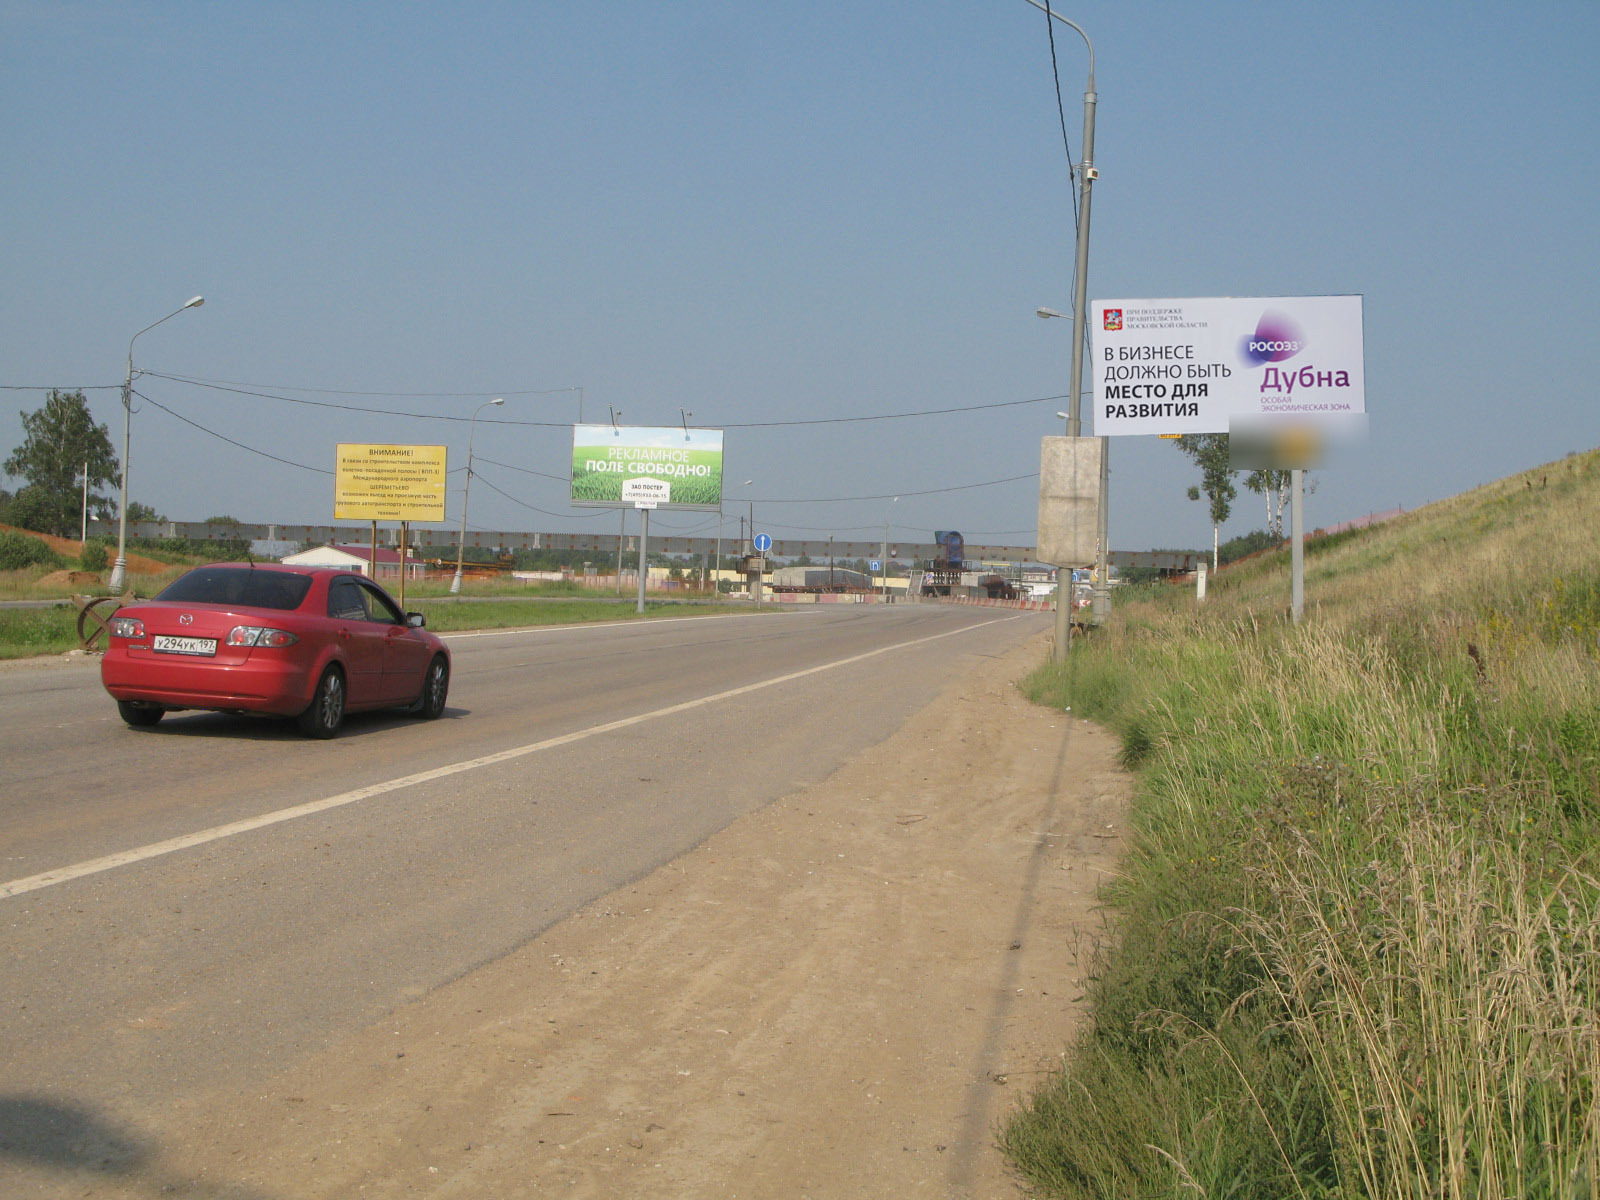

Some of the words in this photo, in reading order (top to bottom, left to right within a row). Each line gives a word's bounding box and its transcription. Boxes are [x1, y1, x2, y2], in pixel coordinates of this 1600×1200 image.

[1104, 347, 1114, 361] В
[1119, 345, 1194, 361] БИЗНЕСЕ
[1104, 364, 1182, 383] ДОЛЖНО
[1187, 363, 1232, 379] БЫТЬ
[1260, 364, 1351, 394] Дубна
[1105, 384, 1167, 399] МЕСТО
[1171, 383, 1208, 400] ДЛЯ
[1260, 396, 1292, 404] ОСОБАЯ
[1261, 403, 1328, 412] ЭКОНОМИЧЕСКАЯ
[1329, 403, 1351, 411] ЗОНА
[1105, 402, 1199, 419] РАЗВИТИЯ
[369, 448, 414, 457] ВНИМАНИЕ!
[608, 447, 689, 463] РЕКЛАМНОЕ
[586, 460, 624, 473] ПОЛЕ
[627, 461, 711, 479] СВОБОДНО!
[198, 639, 214, 649] 197
